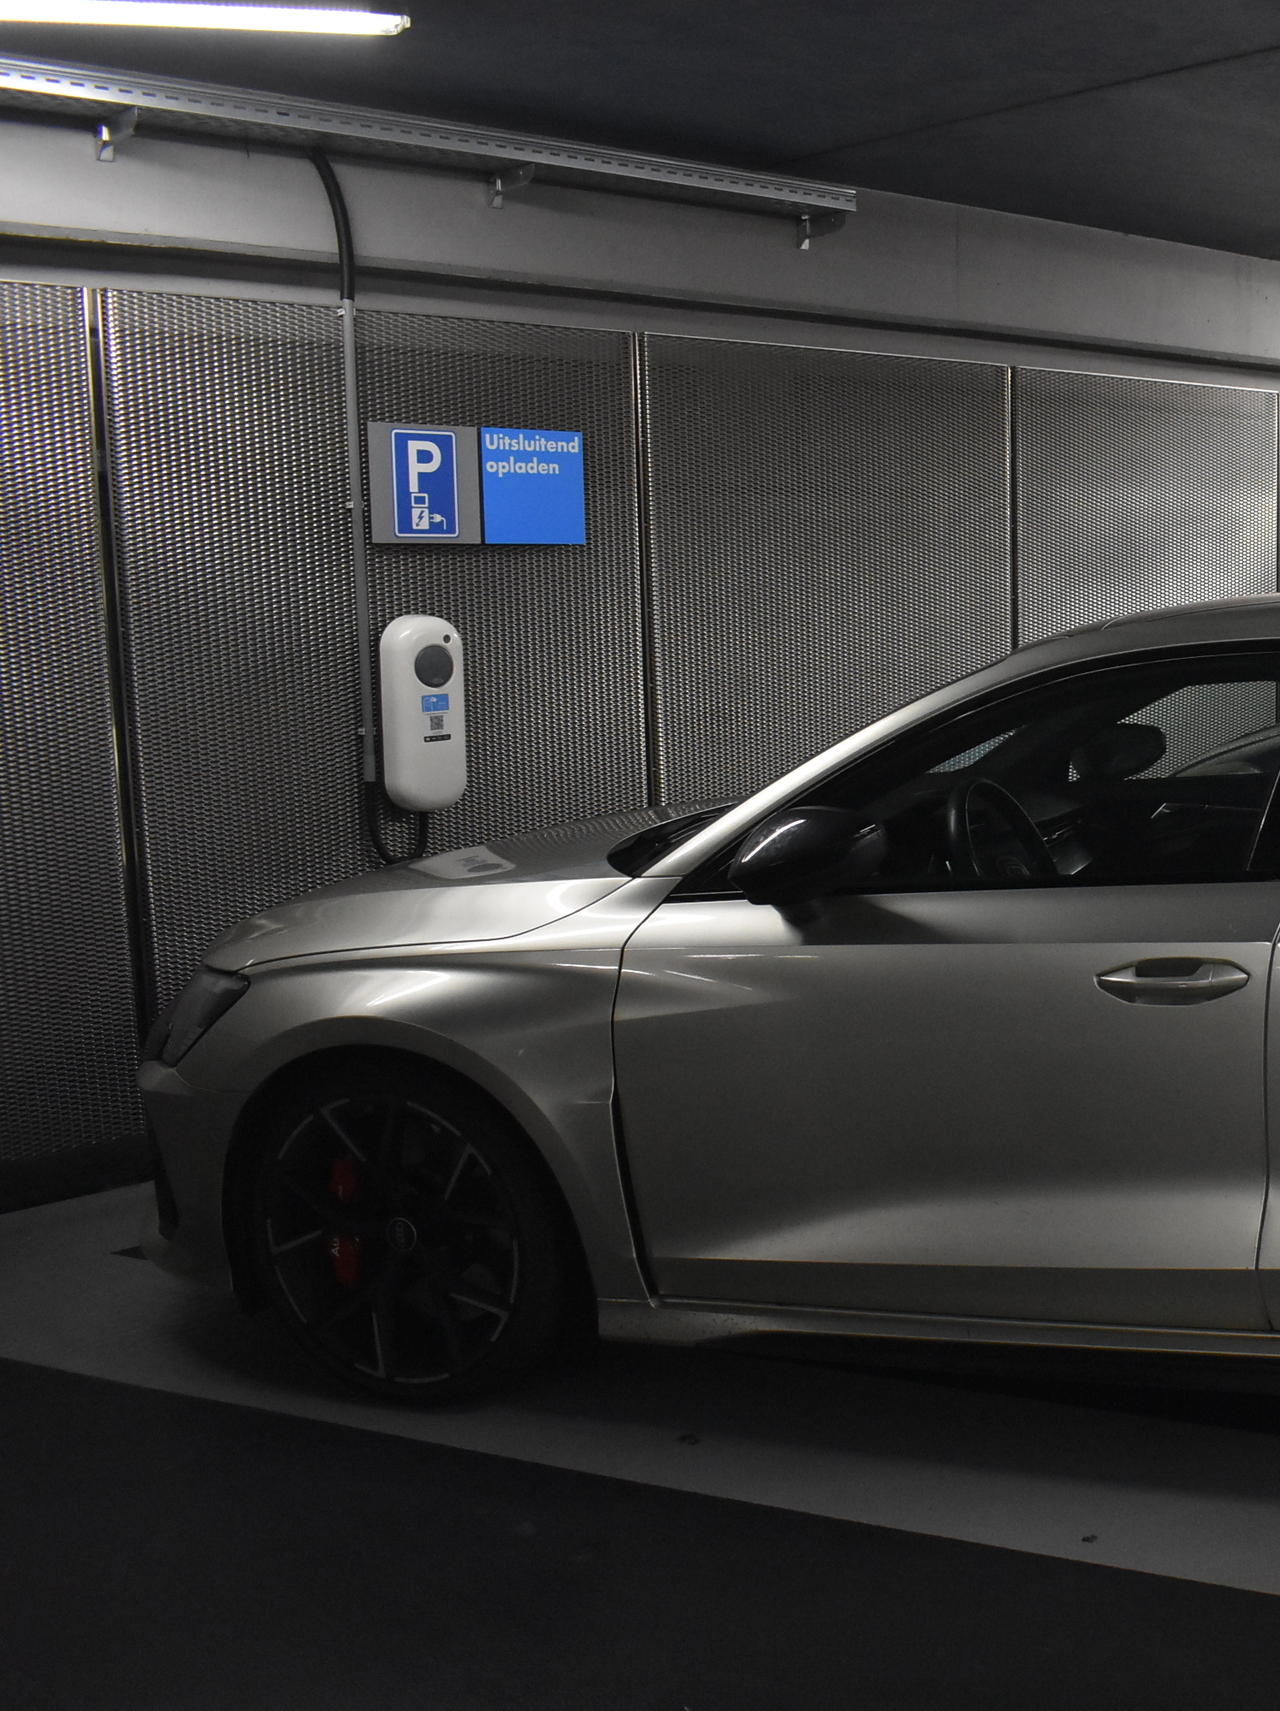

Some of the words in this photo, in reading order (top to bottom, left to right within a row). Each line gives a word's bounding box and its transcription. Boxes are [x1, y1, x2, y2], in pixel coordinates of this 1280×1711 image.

[485, 433, 580, 454] Uitsluitend
[407, 440, 442, 493] P
[485, 456, 561, 478] opladen
